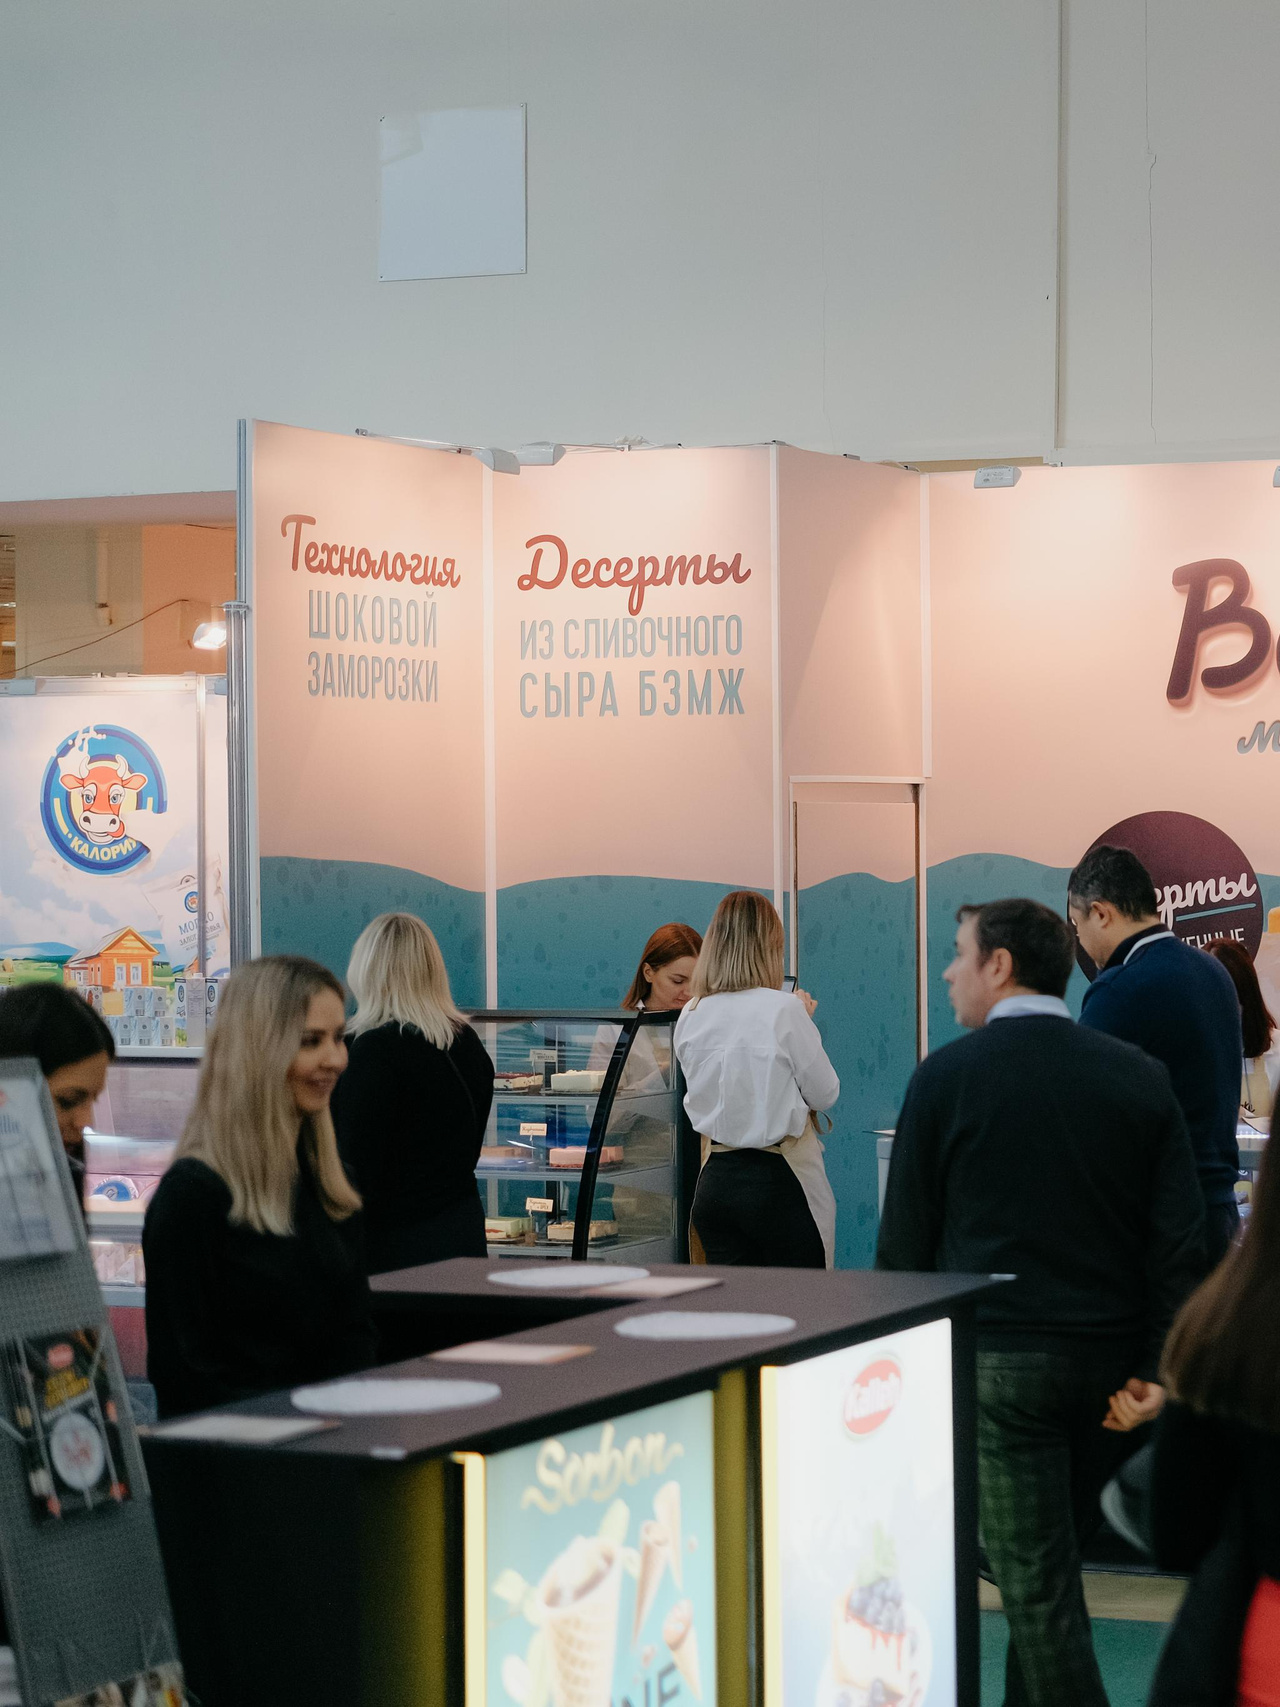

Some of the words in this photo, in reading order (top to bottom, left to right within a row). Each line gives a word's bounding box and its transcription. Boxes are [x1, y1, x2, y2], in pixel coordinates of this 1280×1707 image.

[281, 513, 461, 589] Технология
[516, 534, 752, 616] Десерты
[308, 590, 437, 648] ШОКОВОЙ
[520, 619, 554, 661] ИЗ
[563, 614, 743, 659] СЛИВОЧНОГО
[307, 651, 437, 703] ЗАМОРОЗКИ
[519, 670, 619, 719] СЫРА
[638, 668, 746, 717] БЗМЖ
